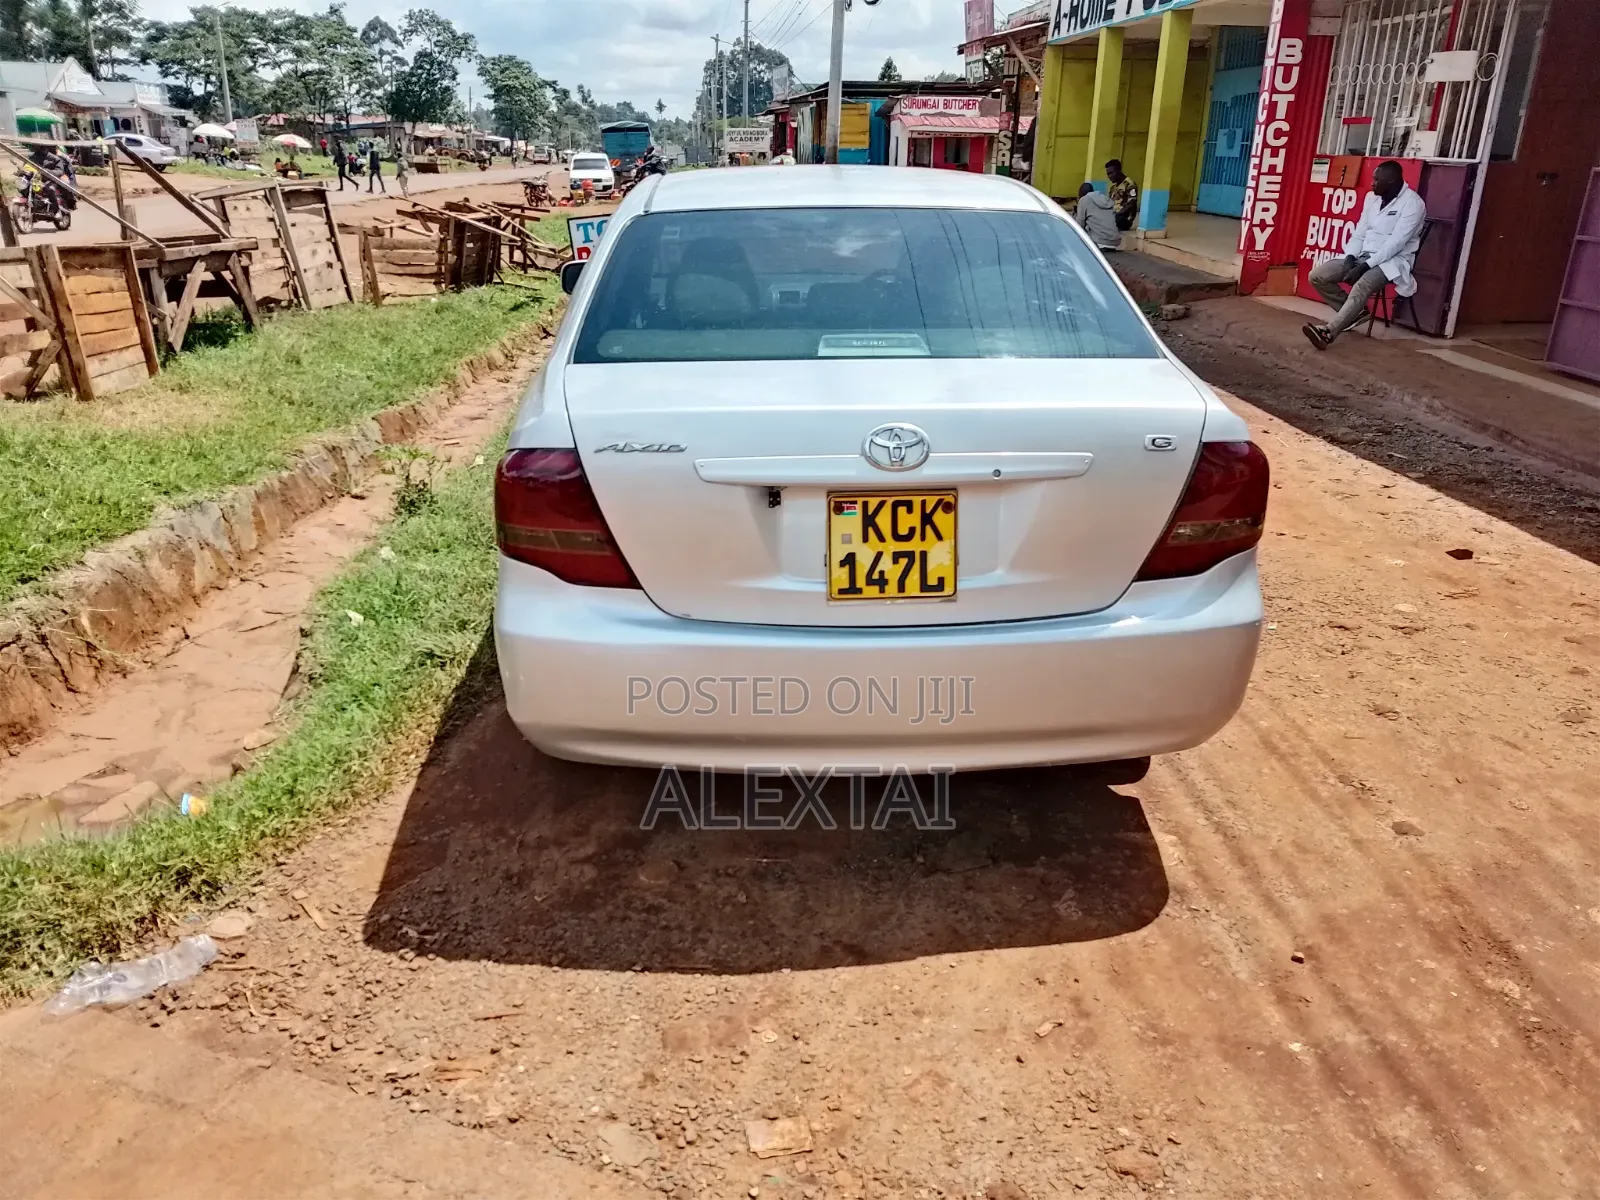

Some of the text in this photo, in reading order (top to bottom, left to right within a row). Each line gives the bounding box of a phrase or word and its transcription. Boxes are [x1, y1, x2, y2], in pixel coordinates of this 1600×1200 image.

[943, 98, 980, 110] BUTCHERY
[1239, 0, 1285, 251] BUTCHERY
[1252, 38, 1303, 251] BUTCHERY
[1321, 187, 1357, 216] TOP
[1306, 215, 1359, 250] BUTC
[593, 440, 688, 453] AXIO
[1151, 437, 1173, 448] G
[861, 497, 945, 544] KCK
[837, 550, 945, 595] 147L
